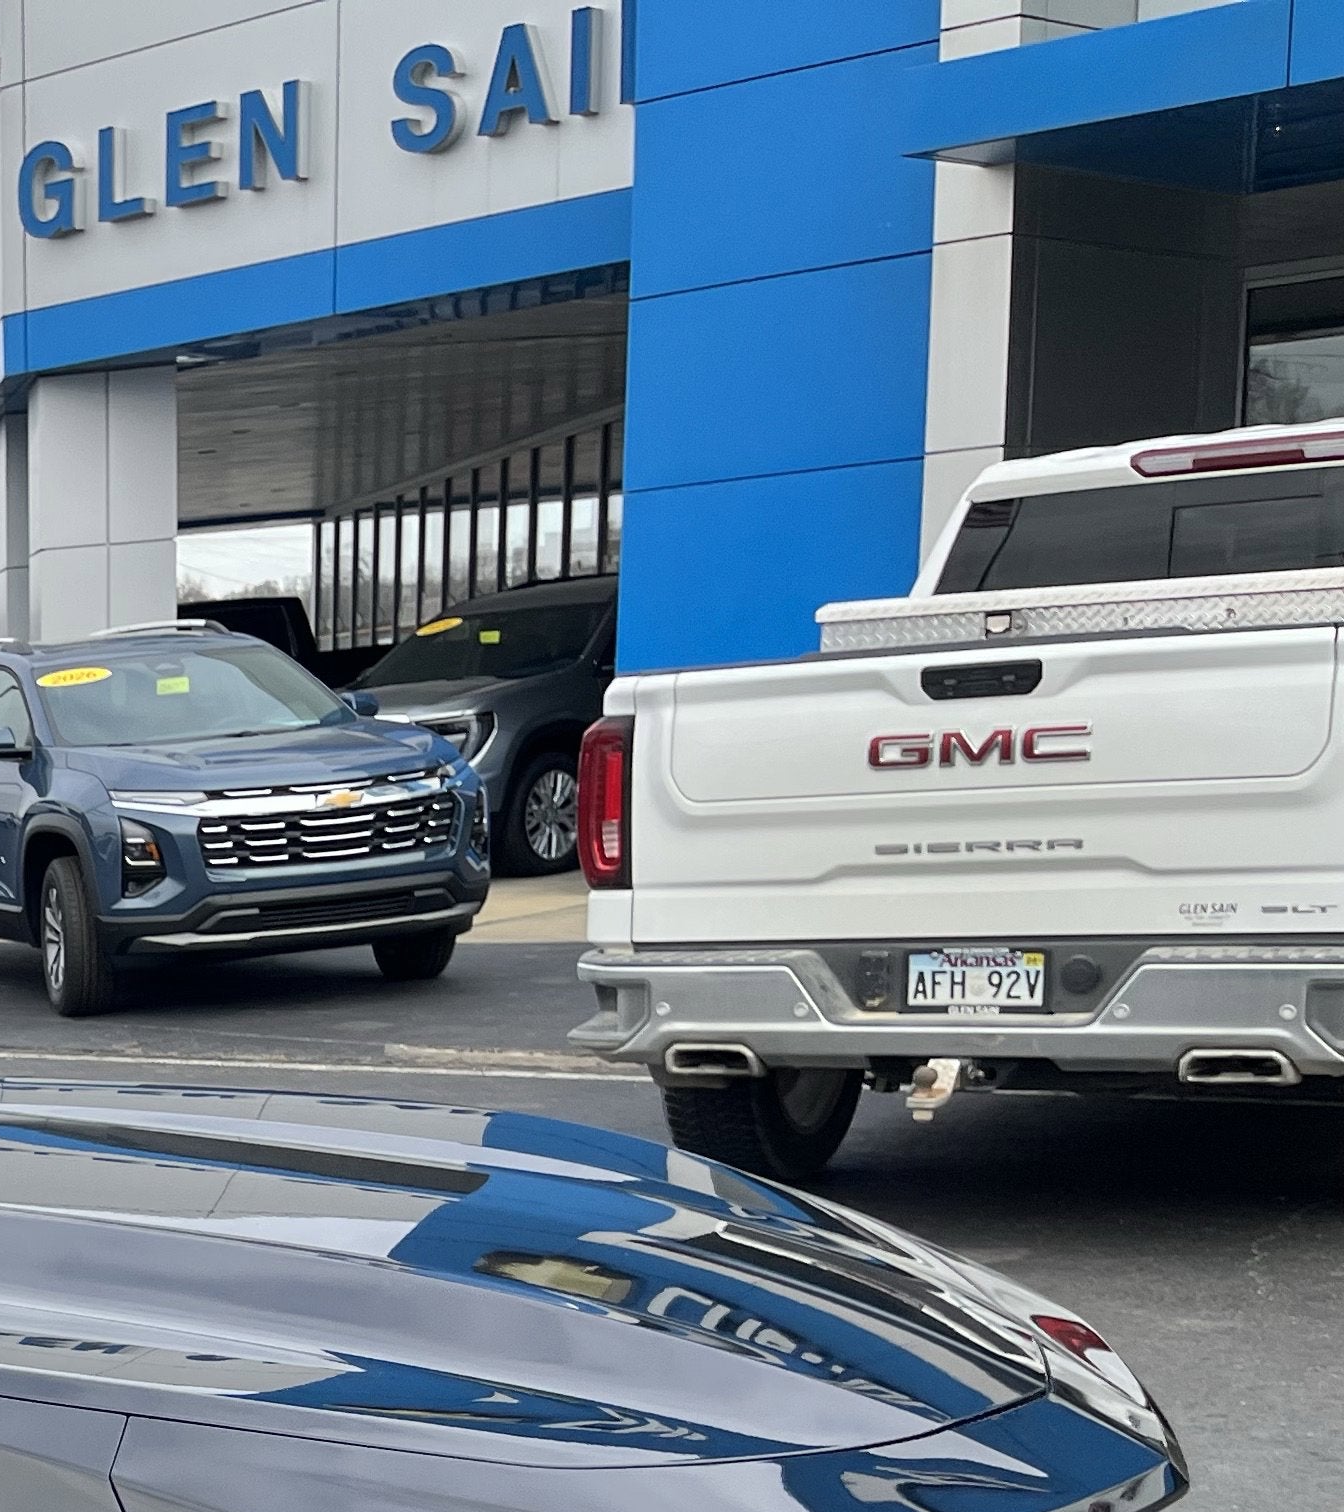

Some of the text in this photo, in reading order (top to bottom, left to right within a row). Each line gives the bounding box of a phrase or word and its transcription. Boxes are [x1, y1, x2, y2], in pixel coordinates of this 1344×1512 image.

[18, 0, 634, 238] GLEN SAI
[867, 722, 1093, 770] GMC
[874, 838, 1085, 855] SIERRA
[1179, 903, 1238, 914] GLEN SAIN
[1261, 904, 1338, 914] SLT
[941, 952, 1017, 968] Arkansas
[913, 970, 1040, 999] AFH 92V
